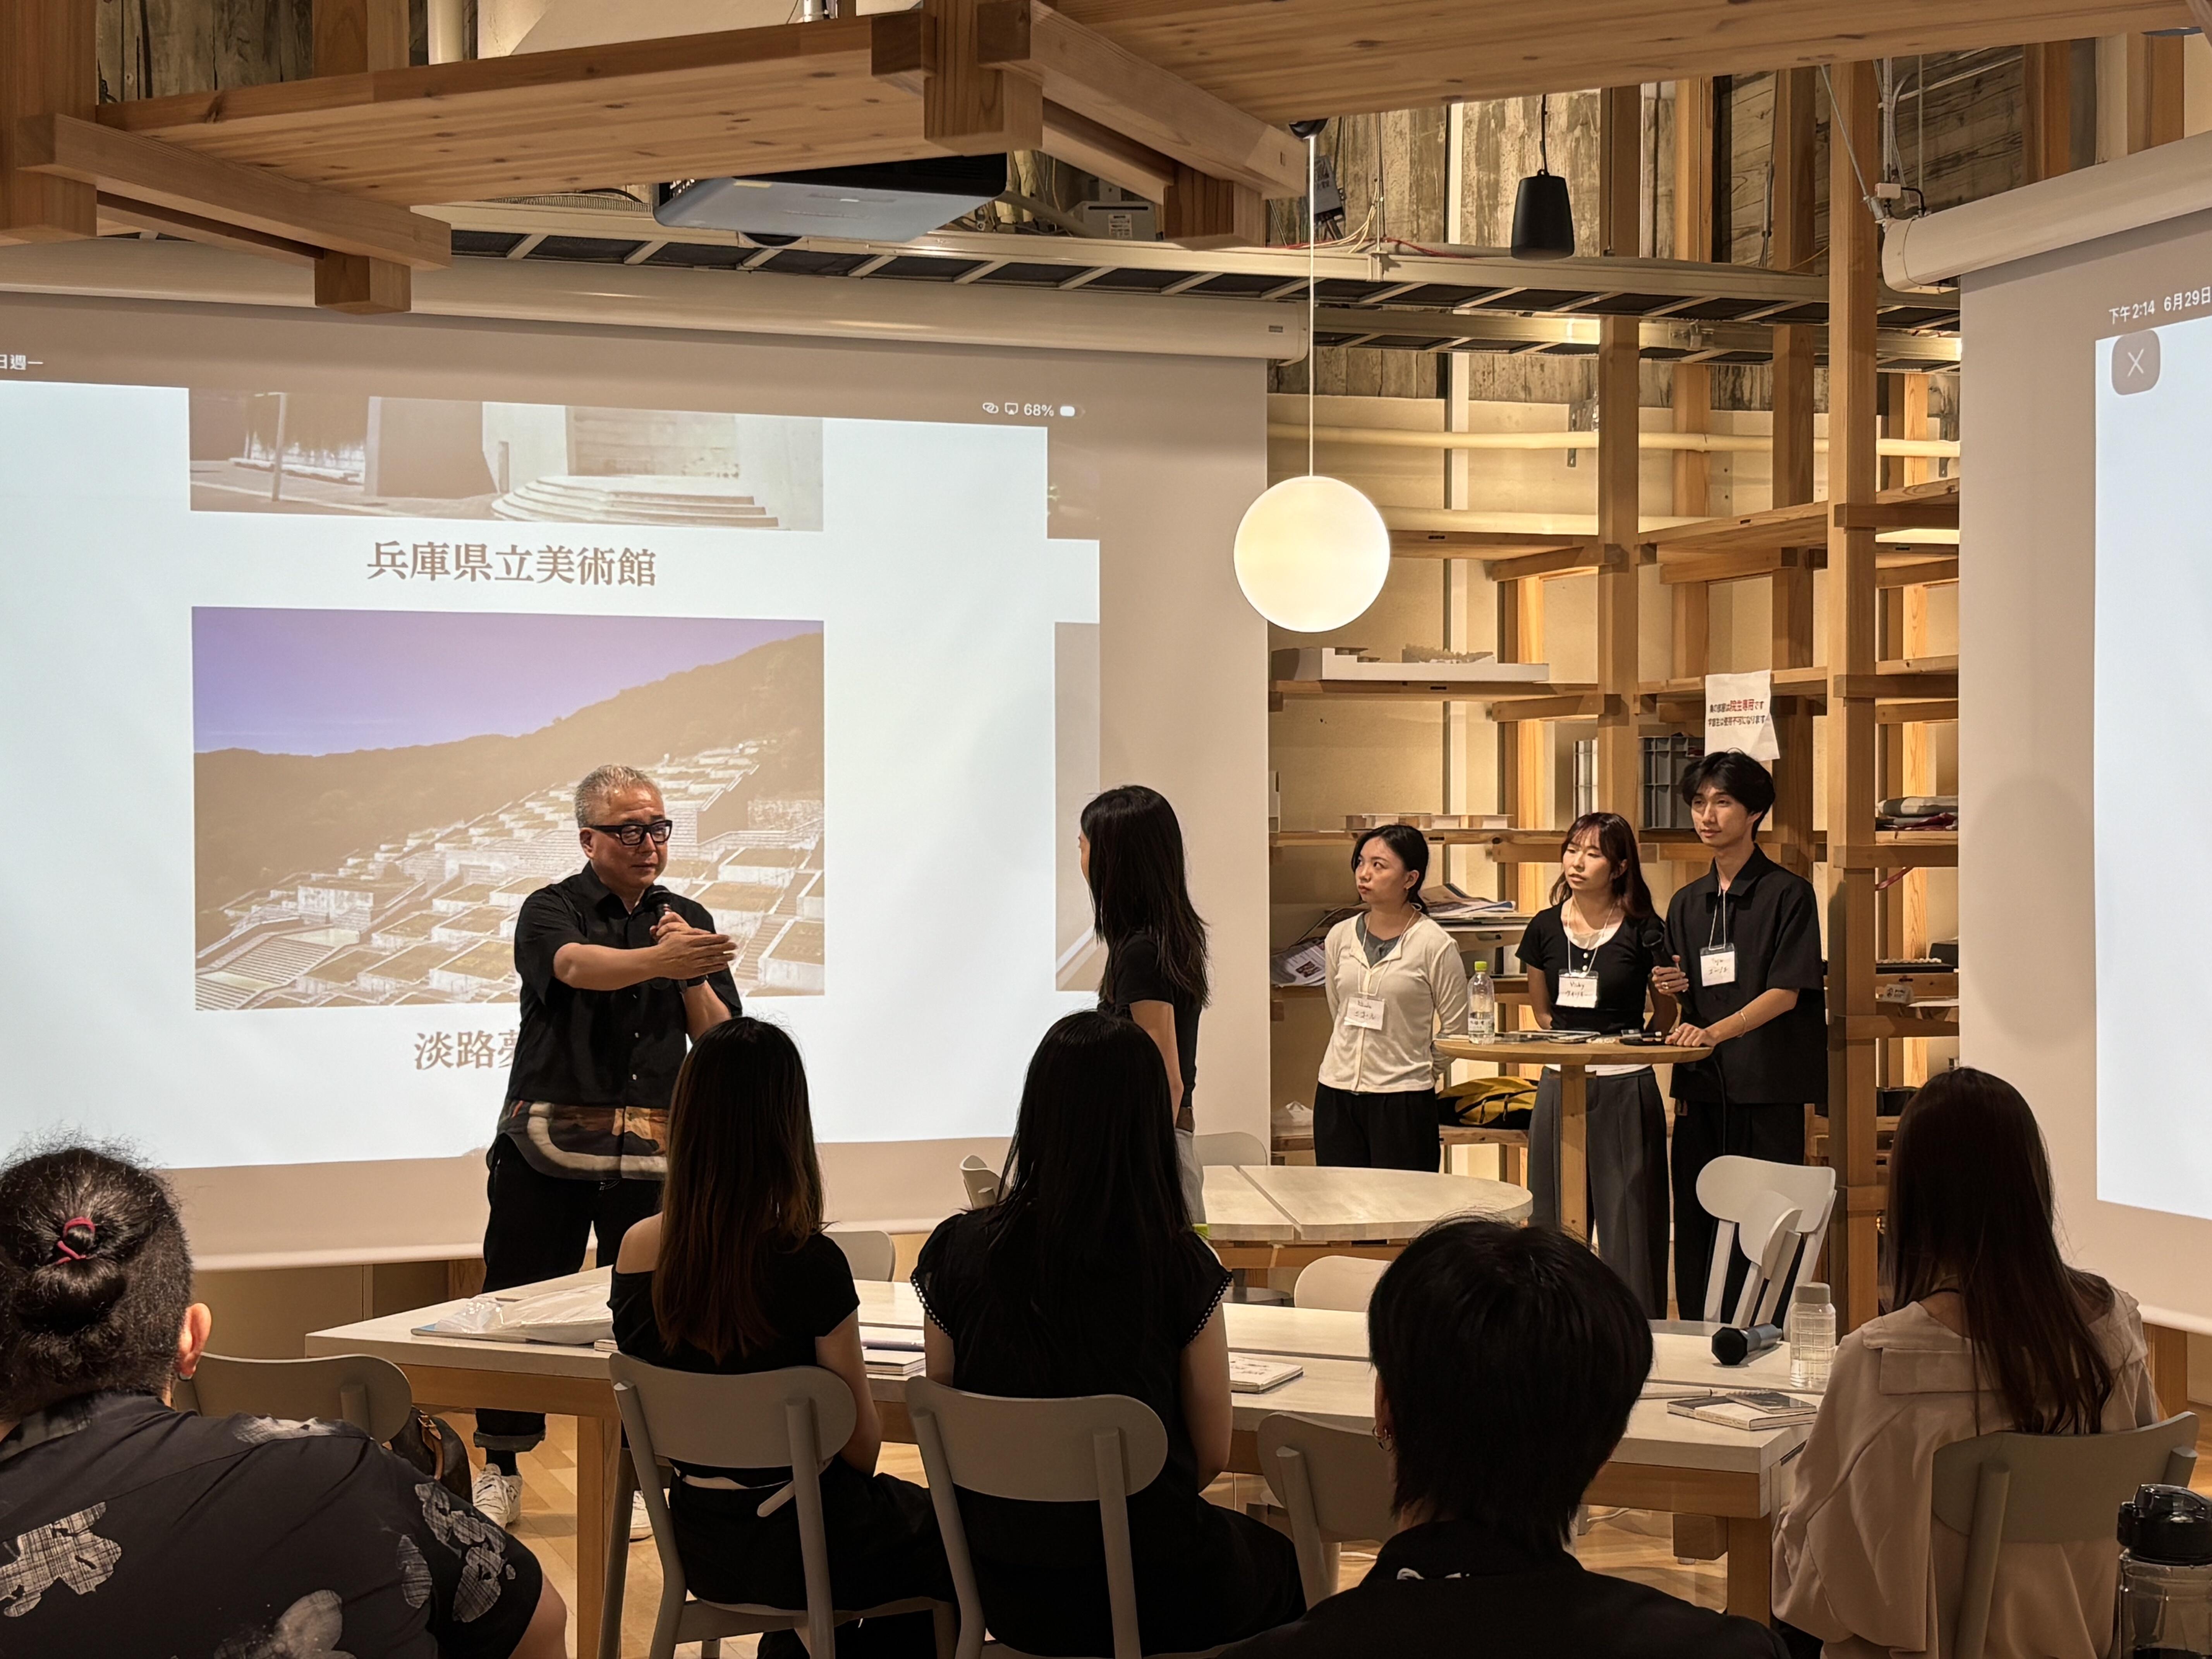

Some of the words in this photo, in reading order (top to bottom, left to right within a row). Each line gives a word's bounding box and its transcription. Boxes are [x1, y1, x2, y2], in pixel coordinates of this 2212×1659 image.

[2164, 286, 2211, 311] 6月29日
[1024, 403, 1054, 417] 68%
[367, 540, 656, 587] 兵庫県立美術館
